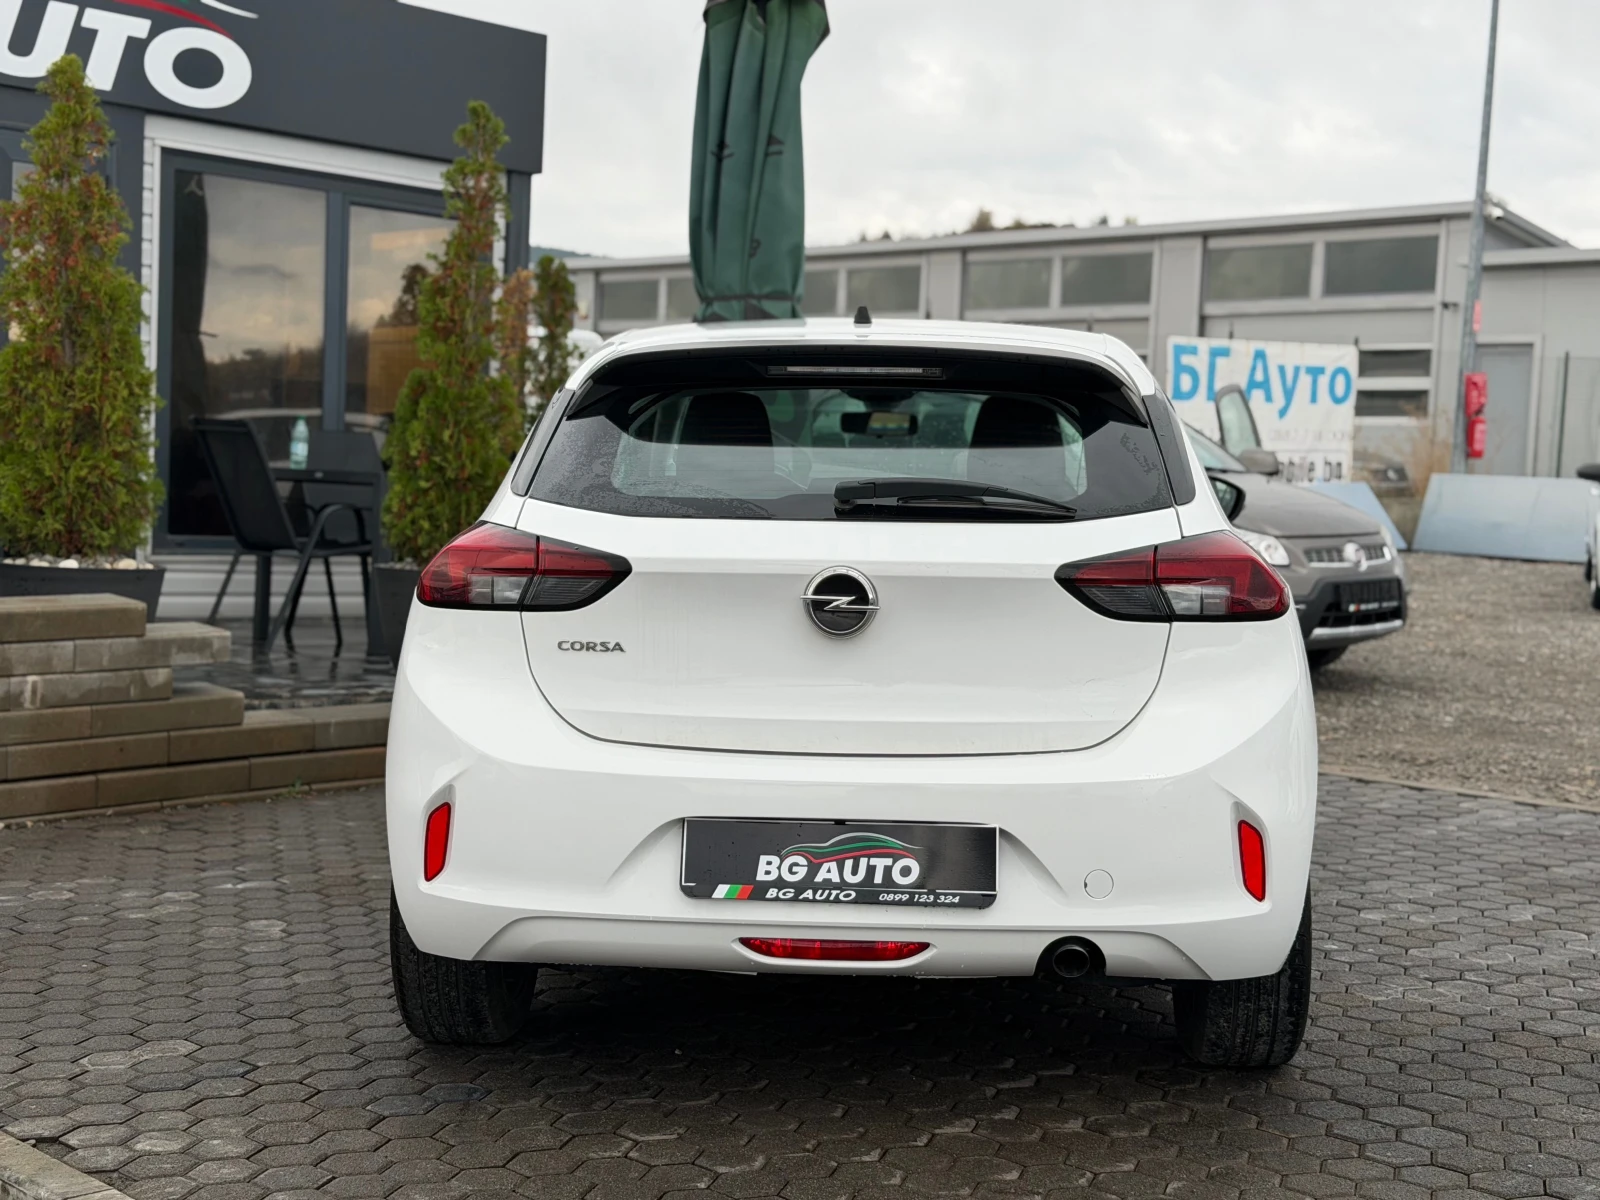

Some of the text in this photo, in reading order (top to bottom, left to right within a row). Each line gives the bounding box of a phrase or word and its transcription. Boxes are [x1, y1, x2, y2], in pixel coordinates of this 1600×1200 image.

[1171, 344, 1353, 421] БГ Ауто
[557, 640, 626, 653] CORSA
[755, 854, 921, 886] BG AUTO
[765, 887, 961, 904] BG AUTO 0899 123 324
